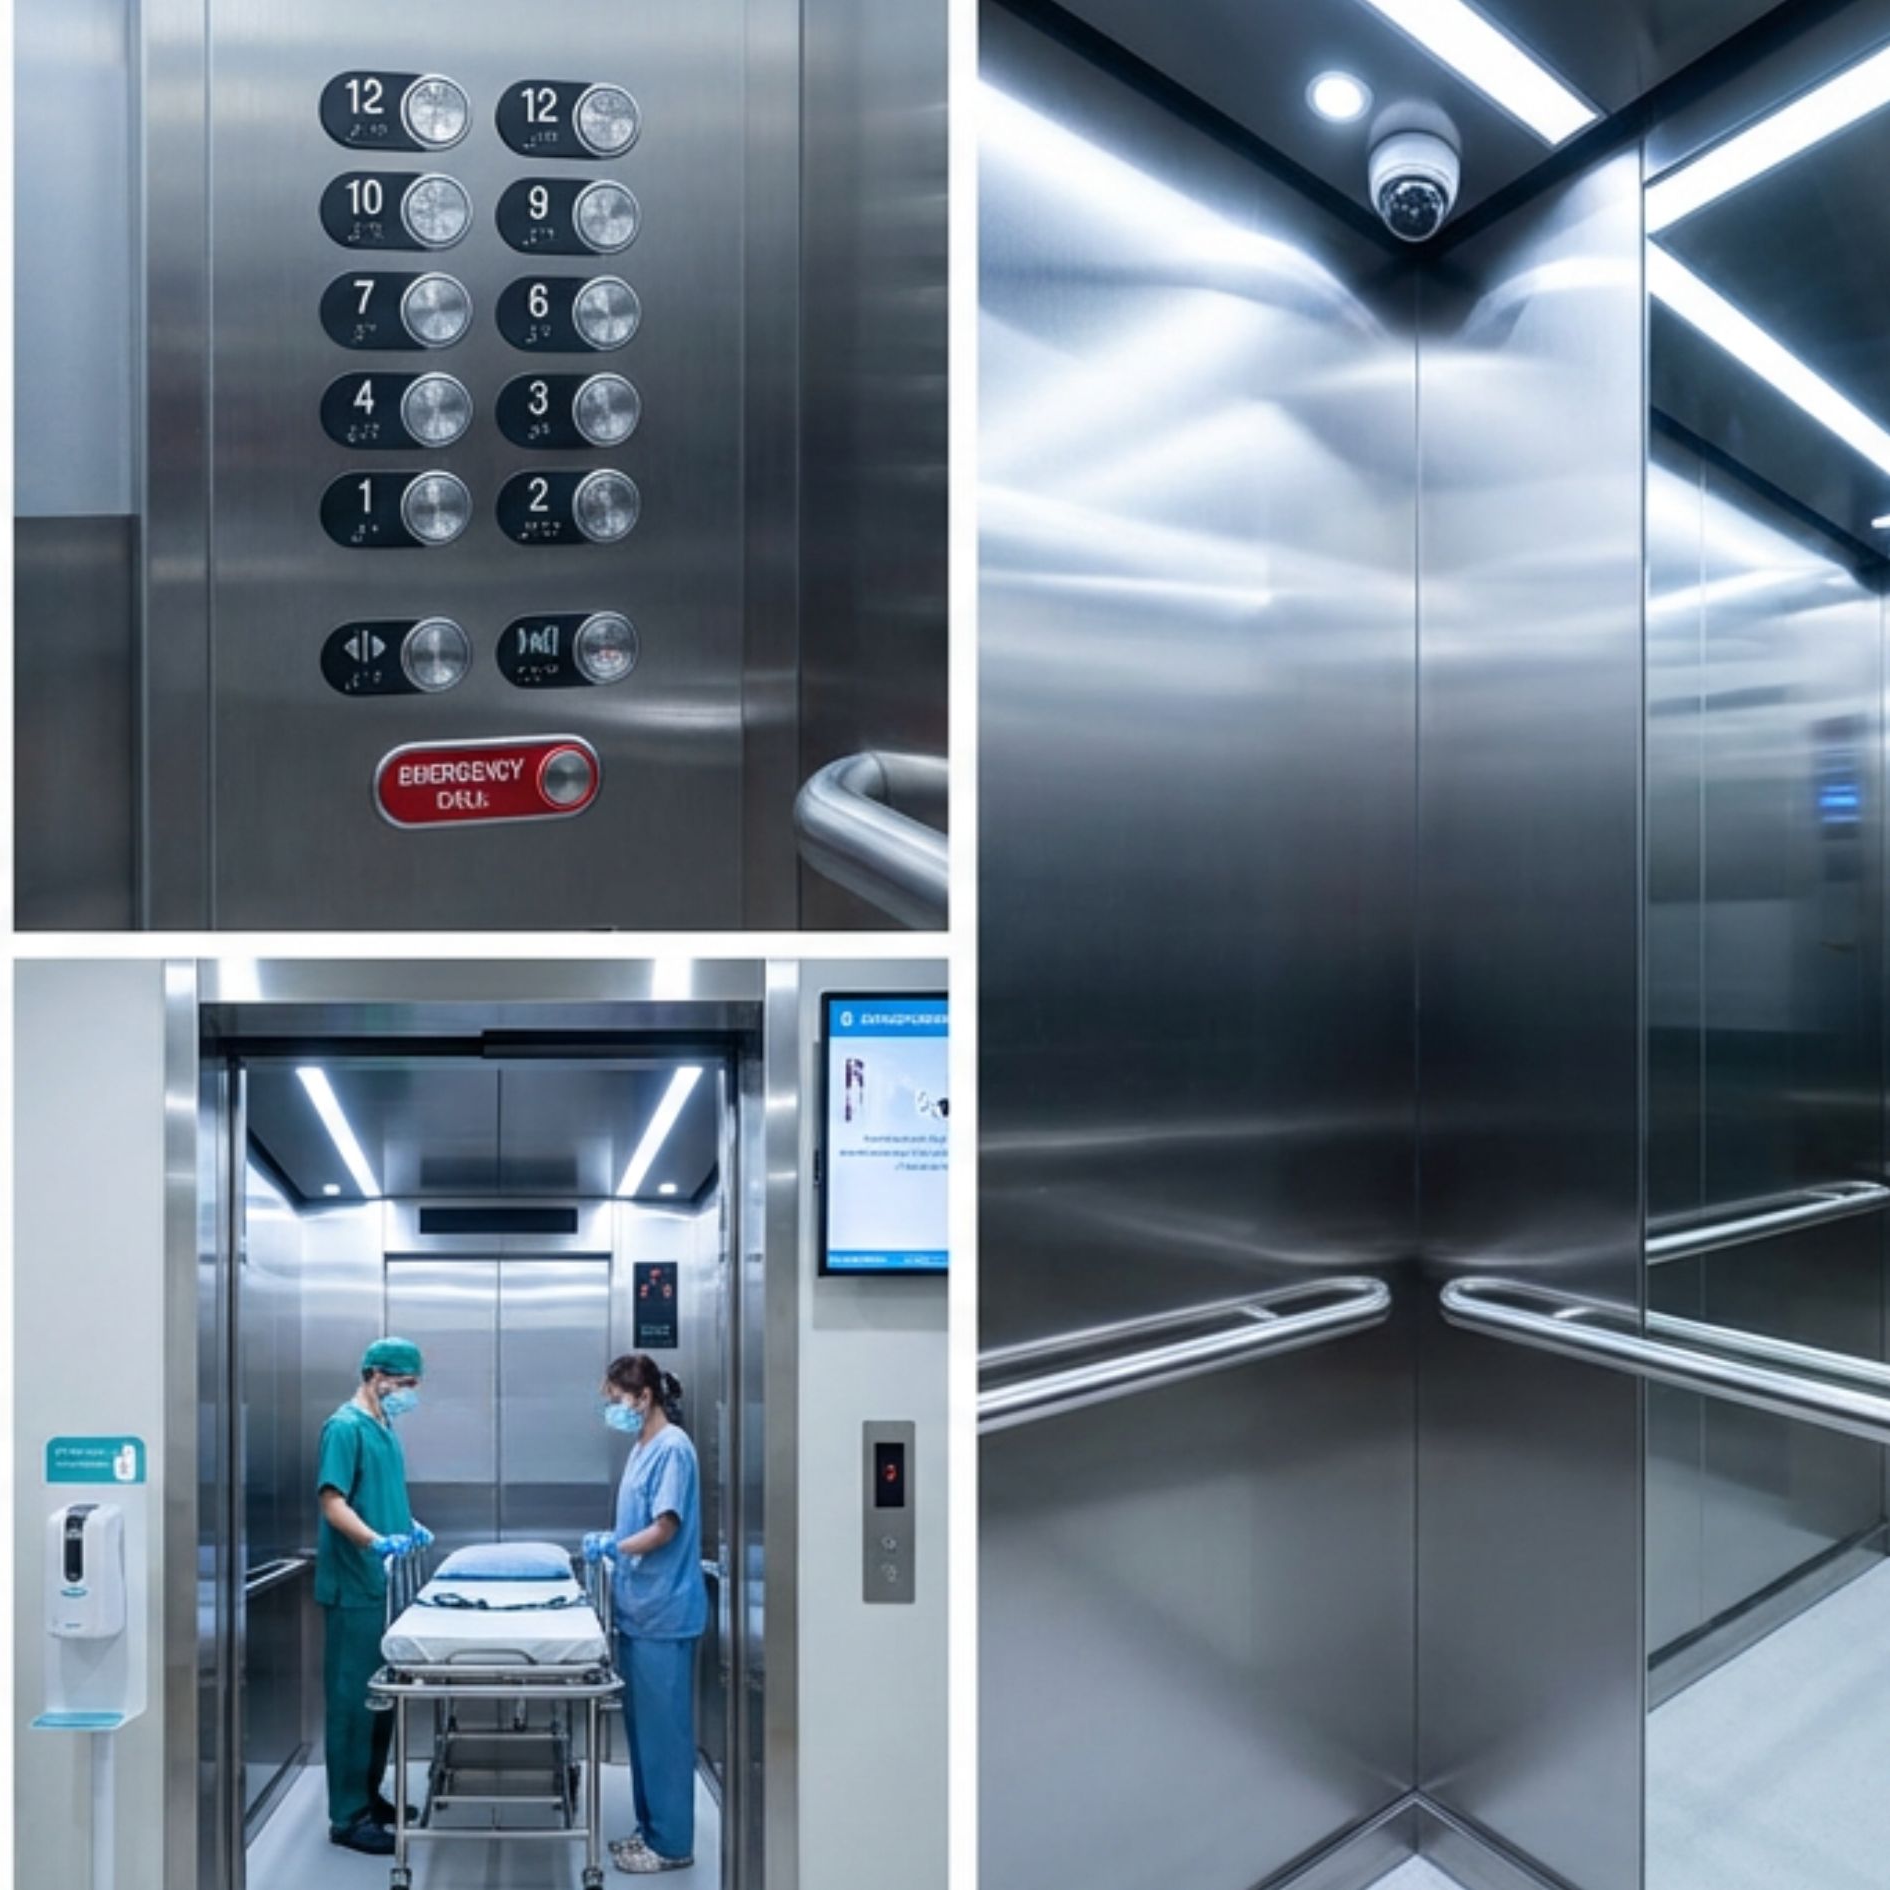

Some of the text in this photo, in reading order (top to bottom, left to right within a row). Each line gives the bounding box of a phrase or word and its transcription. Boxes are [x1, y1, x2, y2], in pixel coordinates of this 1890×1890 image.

[345, 78, 384, 115] 12
[521, 87, 559, 123] 12
[345, 179, 383, 215] 10
[529, 185, 549, 220] 9
[353, 279, 375, 315] 7
[529, 283, 549, 318] 6
[353, 379, 374, 415] 4
[528, 380, 548, 415] 3
[358, 479, 371, 513] 1
[528, 477, 549, 512] 2
